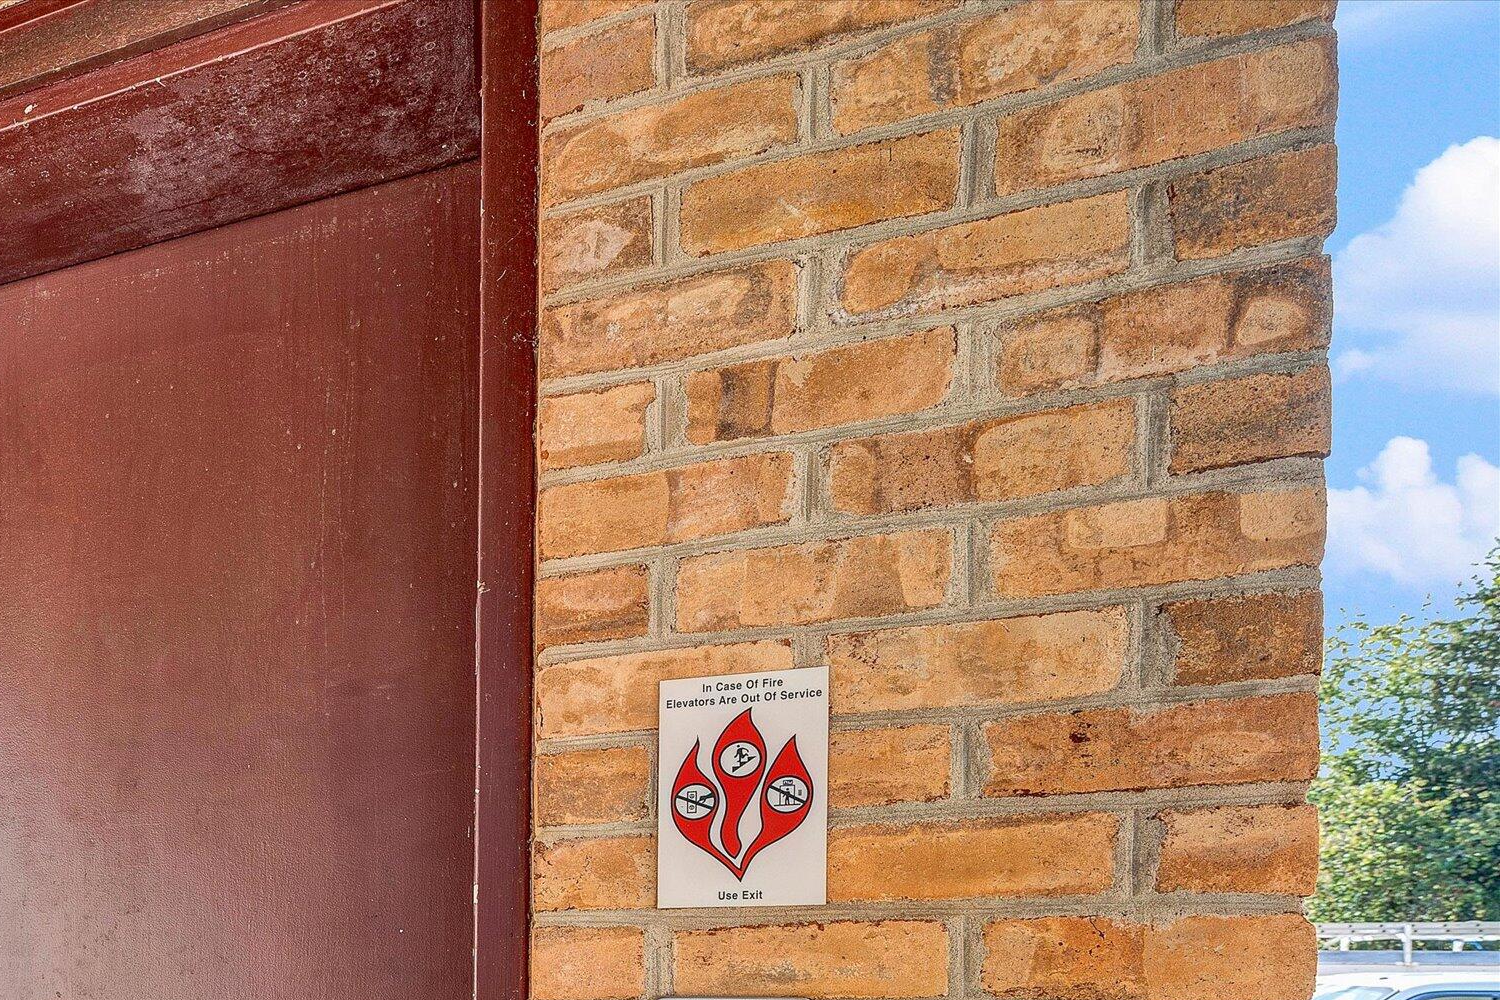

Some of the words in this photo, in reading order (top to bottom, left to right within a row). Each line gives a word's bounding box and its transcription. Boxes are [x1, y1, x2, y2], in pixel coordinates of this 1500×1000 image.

[702, 683, 712, 693] In
[715, 682, 742, 692] Case
[746, 679, 759, 689] Of
[762, 678, 784, 688] Fire
[666, 697, 716, 709] Elevators
[718, 695, 737, 705] Are
[741, 693, 760, 704] Out
[764, 691, 777, 701] Of
[780, 688, 823, 700] Service
[718, 891, 738, 900] Use
[742, 890, 763, 900] Exit
